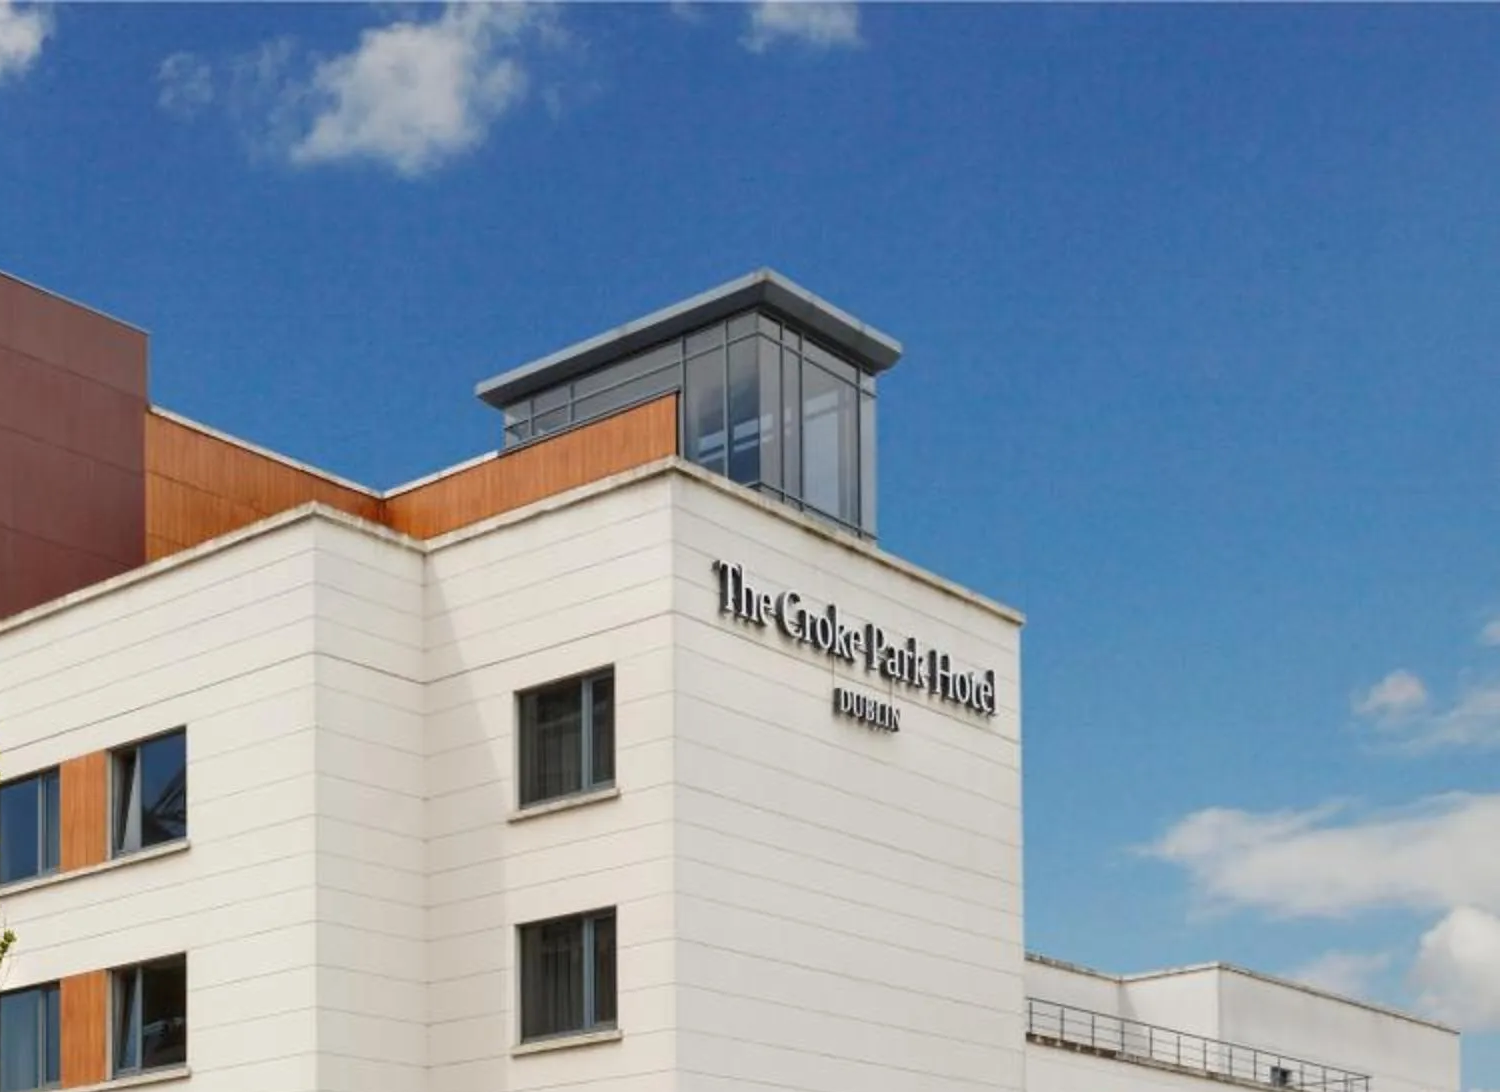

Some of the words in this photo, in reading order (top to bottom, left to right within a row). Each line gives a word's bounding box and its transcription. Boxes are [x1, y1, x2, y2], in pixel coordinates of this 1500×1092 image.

[713, 559, 774, 627] The
[776, 590, 865, 662] Croke
[865, 622, 928, 689] Park
[928, 648, 998, 716] Hotel
[833, 687, 900, 733] DUBLIN
